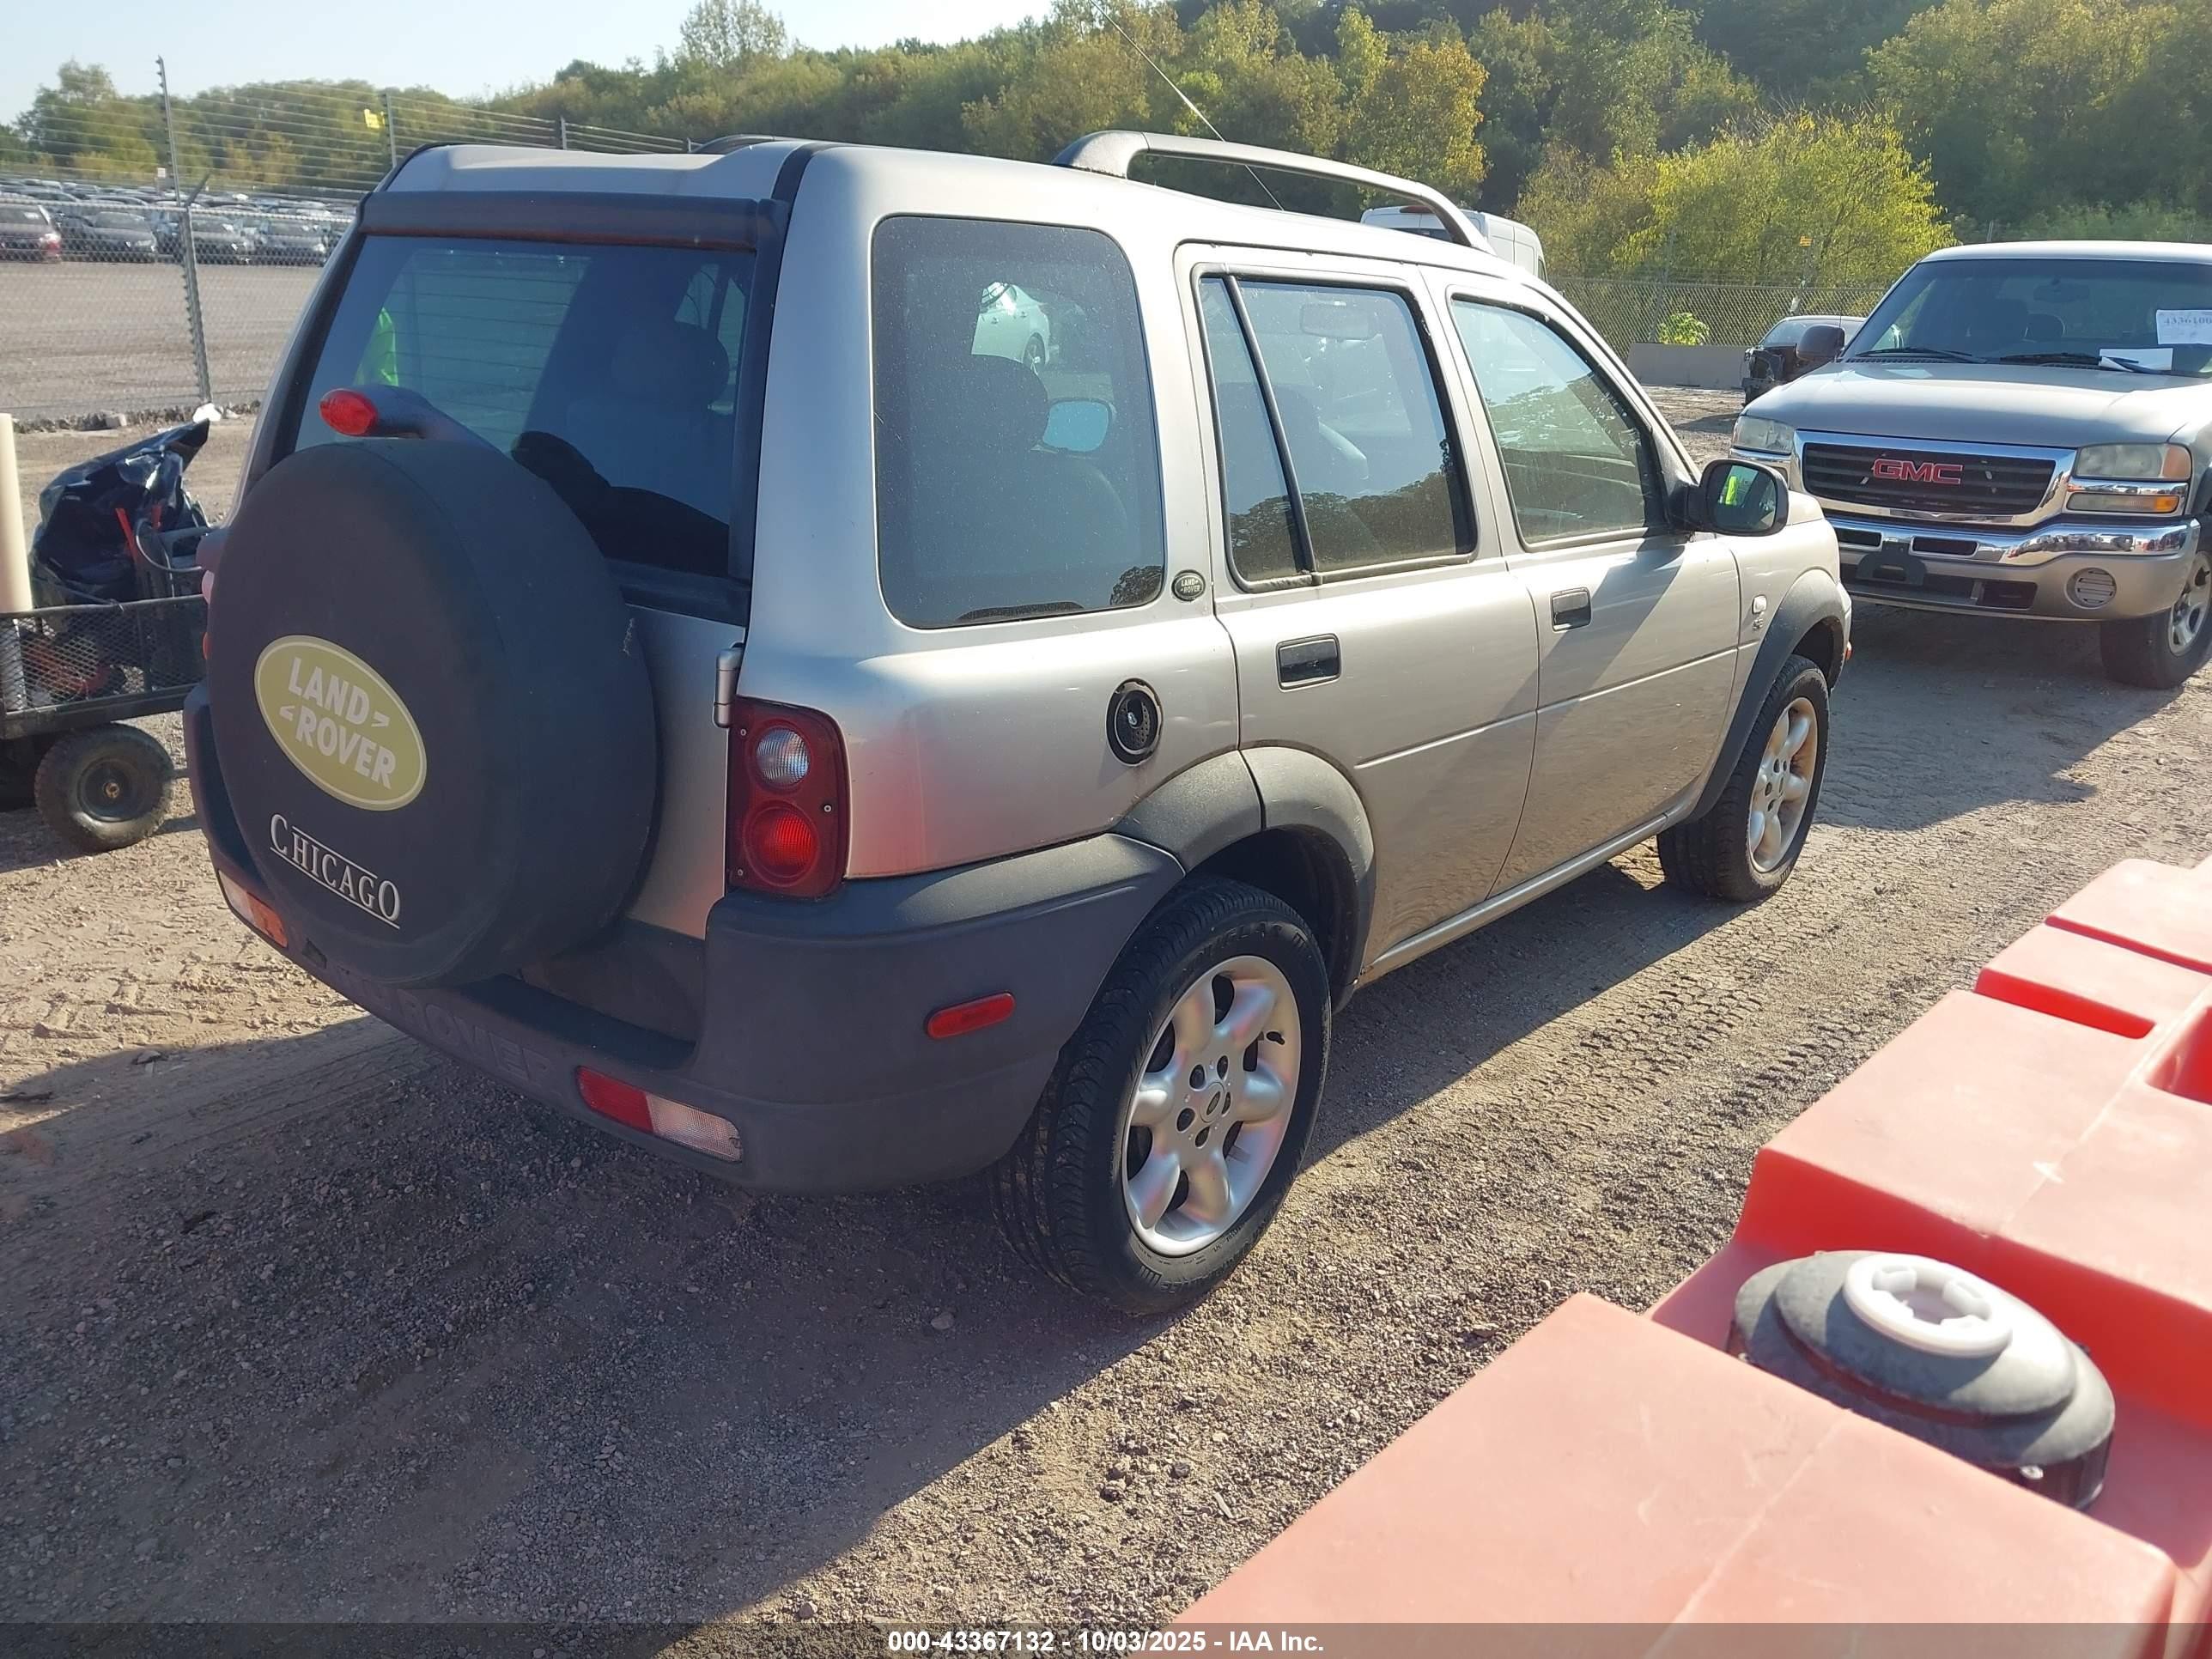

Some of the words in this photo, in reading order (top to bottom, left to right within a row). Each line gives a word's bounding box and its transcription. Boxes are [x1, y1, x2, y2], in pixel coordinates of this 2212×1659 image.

[1874, 459, 1963, 485] GMC
[1181, 579, 1195, 587] LAND
[1183, 585, 1200, 593] ROVER
[289, 657, 370, 727] LAND
[295, 707, 397, 789] ROVER
[270, 813, 401, 922] CHICAGO
